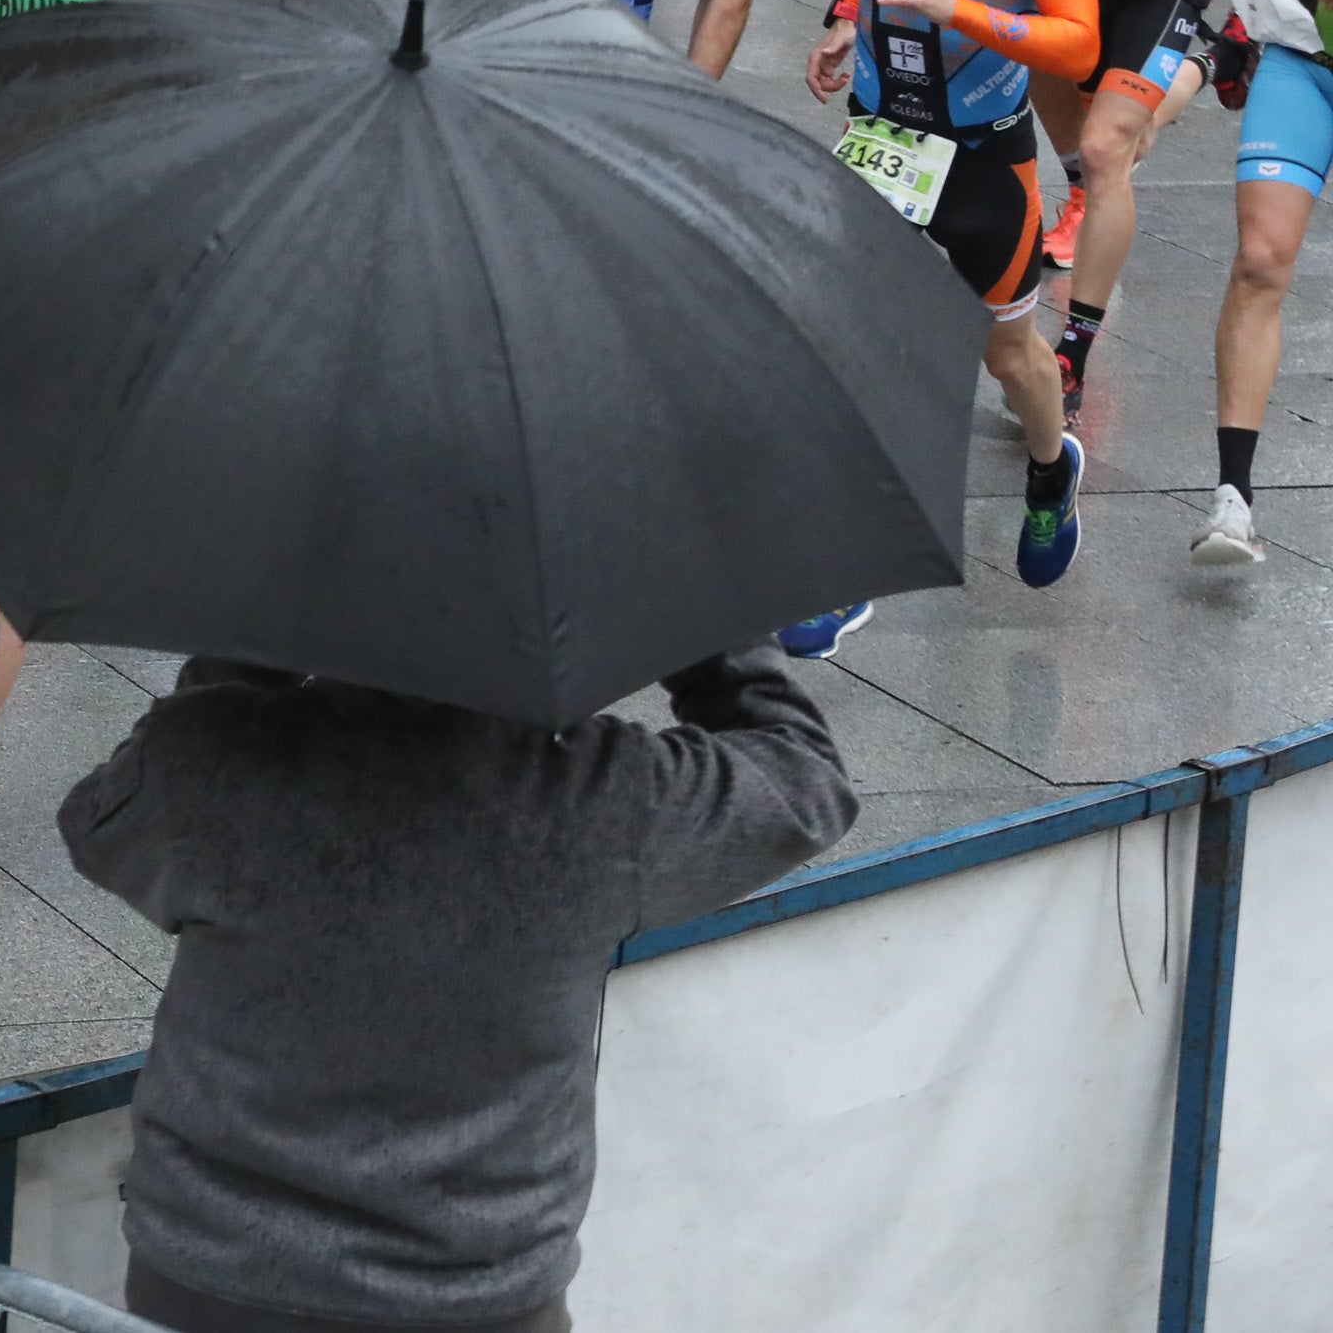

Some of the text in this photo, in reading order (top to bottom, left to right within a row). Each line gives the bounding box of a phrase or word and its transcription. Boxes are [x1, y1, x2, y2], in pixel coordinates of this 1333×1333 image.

[886, 67, 931, 86] OVIEDO
[890, 100, 935, 122] IGLESIAS
[835, 140, 904, 179] 4143
